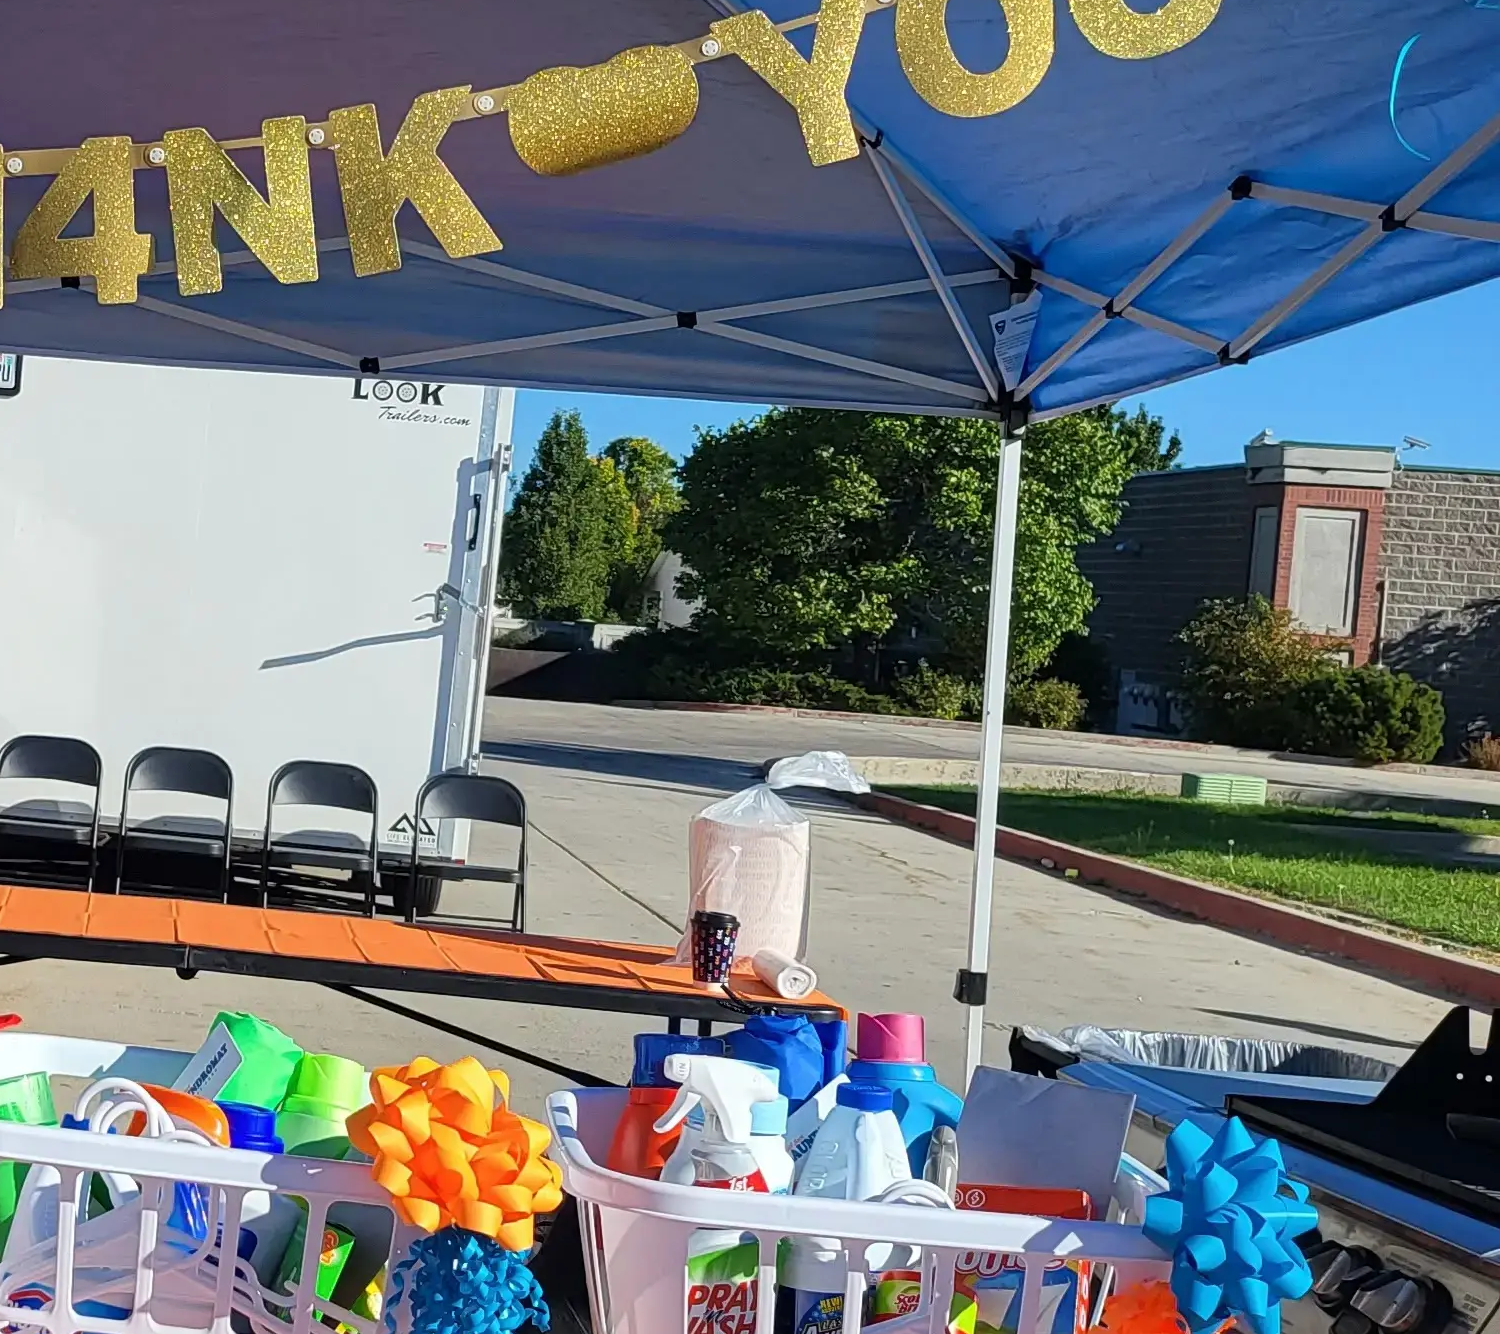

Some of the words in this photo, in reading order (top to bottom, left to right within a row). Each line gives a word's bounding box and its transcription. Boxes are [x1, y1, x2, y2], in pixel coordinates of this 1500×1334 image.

[351, 378, 447, 406] LOOK
[378, 406, 471, 426] Trailers.com
[187, 1042, 228, 1096] NDROMAT
